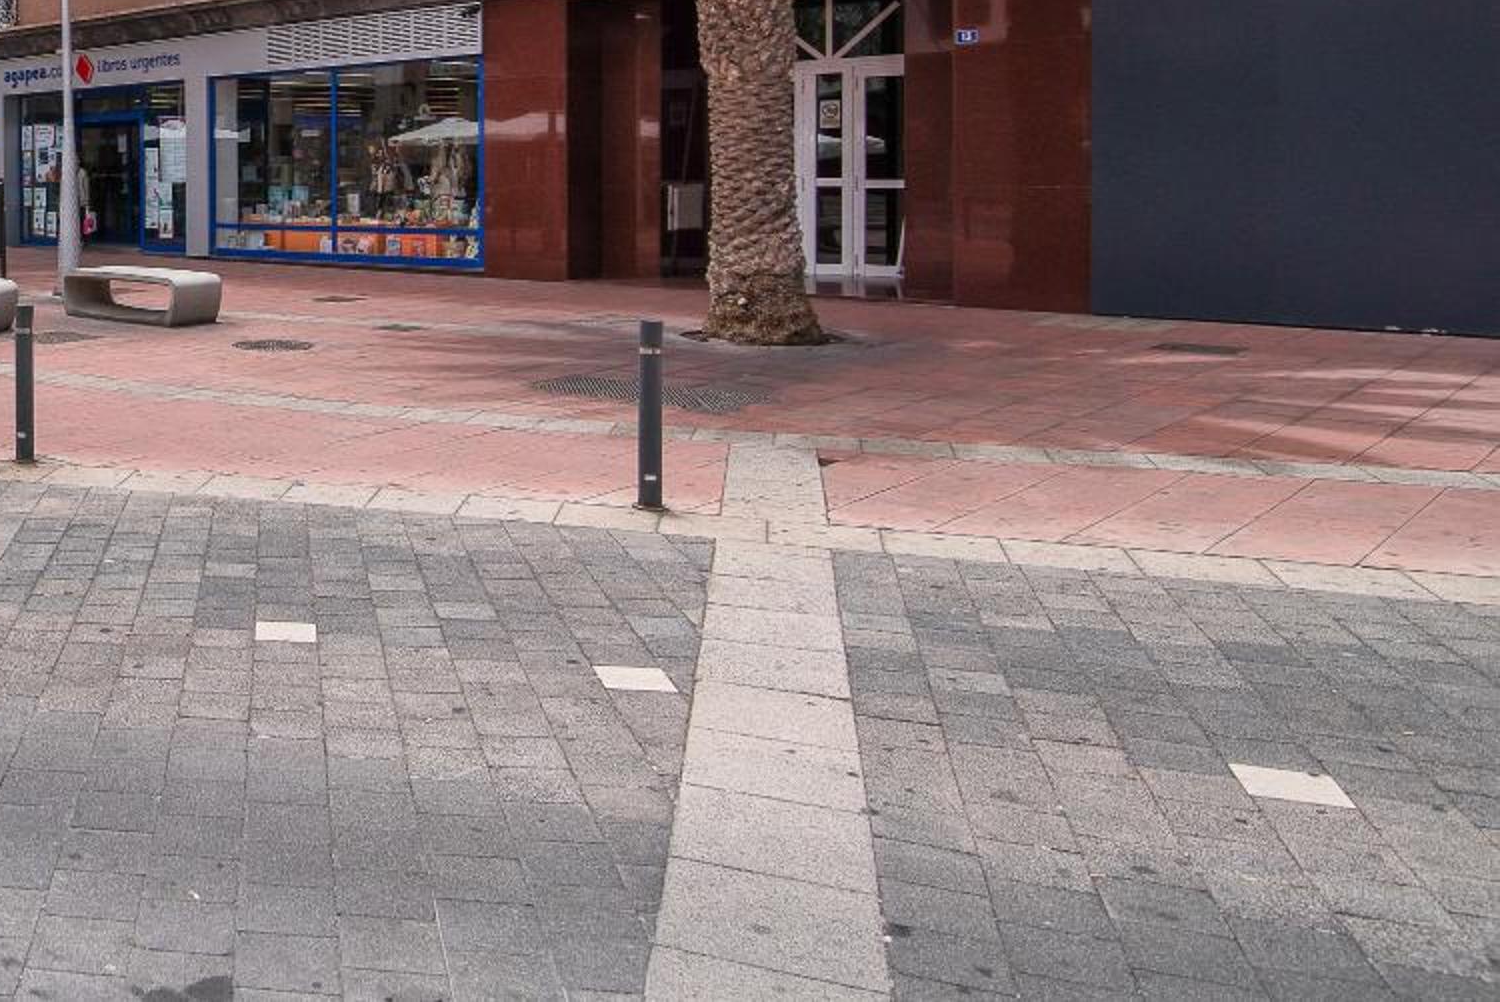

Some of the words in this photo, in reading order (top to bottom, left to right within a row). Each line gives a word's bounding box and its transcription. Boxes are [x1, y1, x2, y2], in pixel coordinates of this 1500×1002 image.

[4, 67, 73, 88] agapea.co
[97, 59, 128, 73] libros
[130, 53, 181, 73] urgentes
